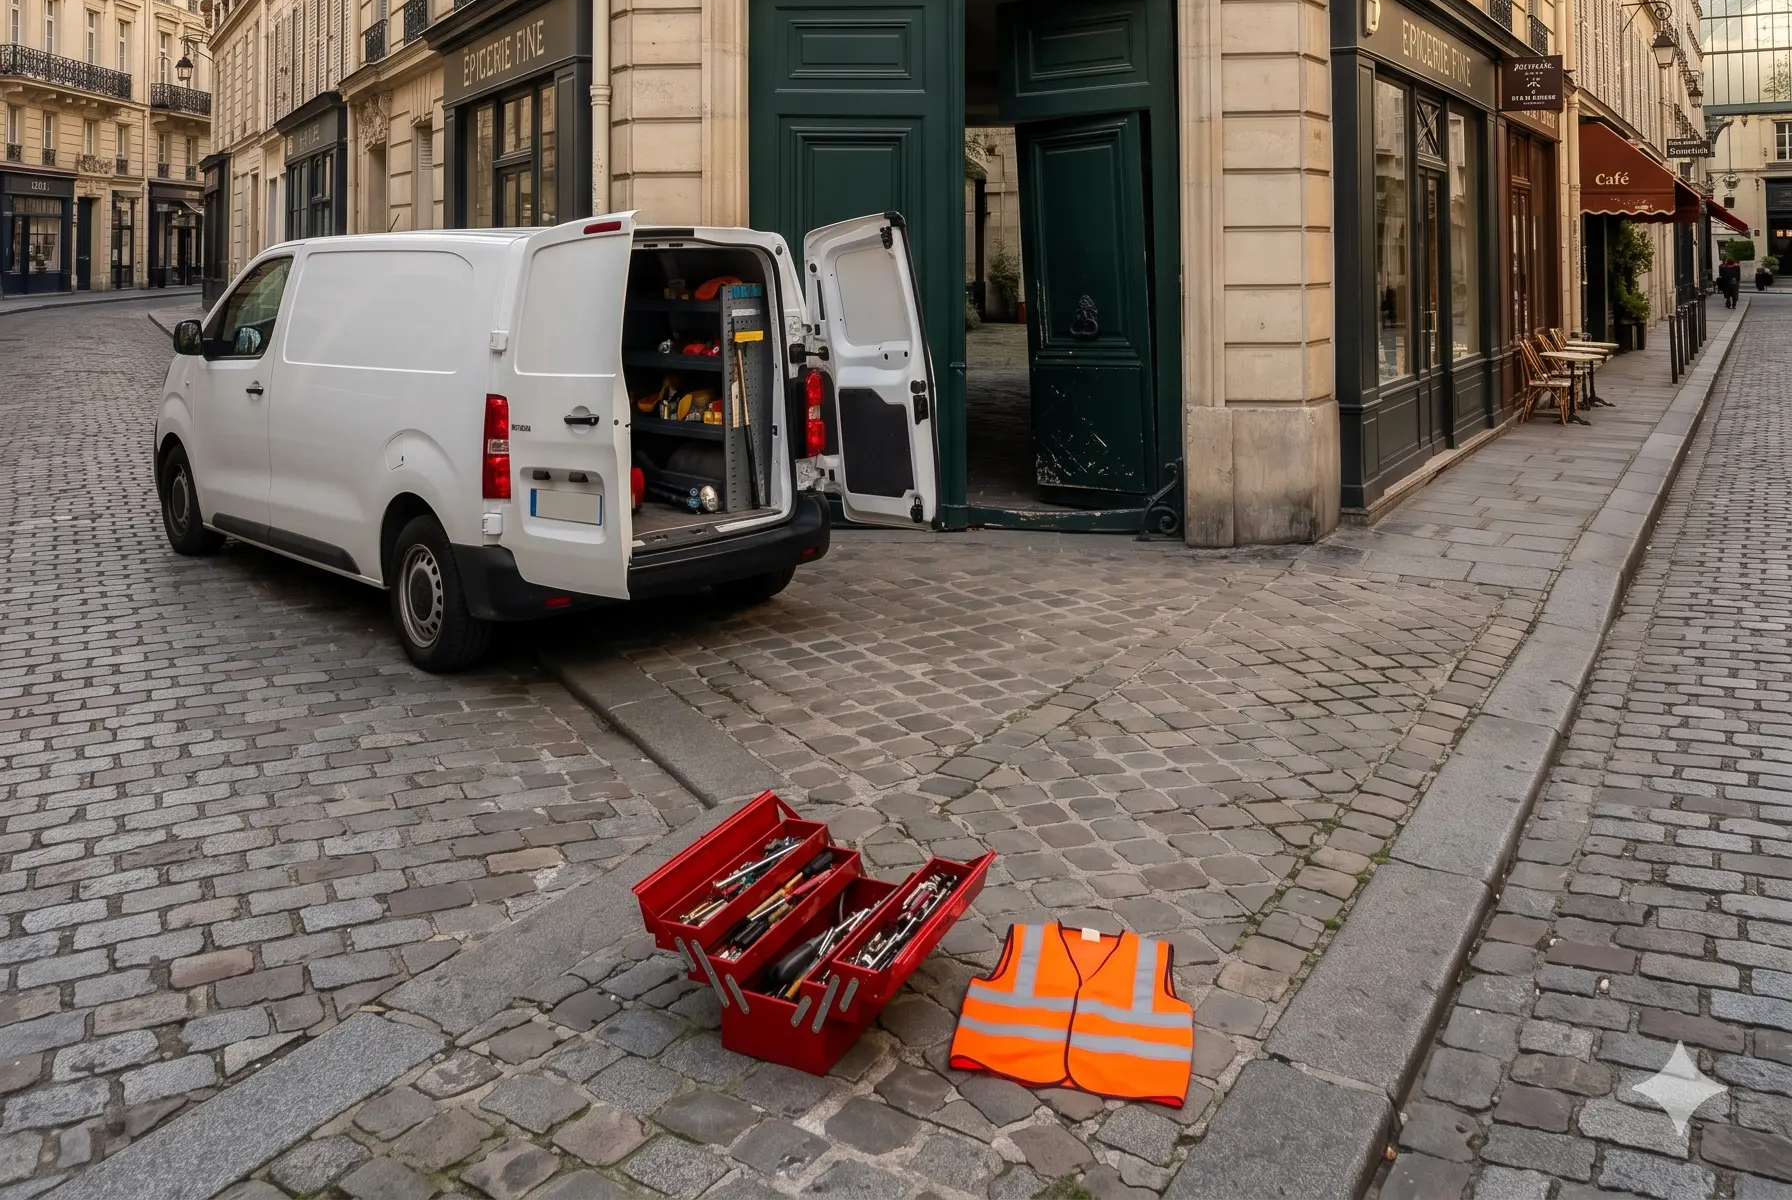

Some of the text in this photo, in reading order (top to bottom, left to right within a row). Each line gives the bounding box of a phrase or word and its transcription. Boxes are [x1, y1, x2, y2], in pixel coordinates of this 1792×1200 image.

[516, 19, 545, 65] FINE
[1452, 47, 1472, 88] FINE
[1595, 171, 1630, 185] Café
